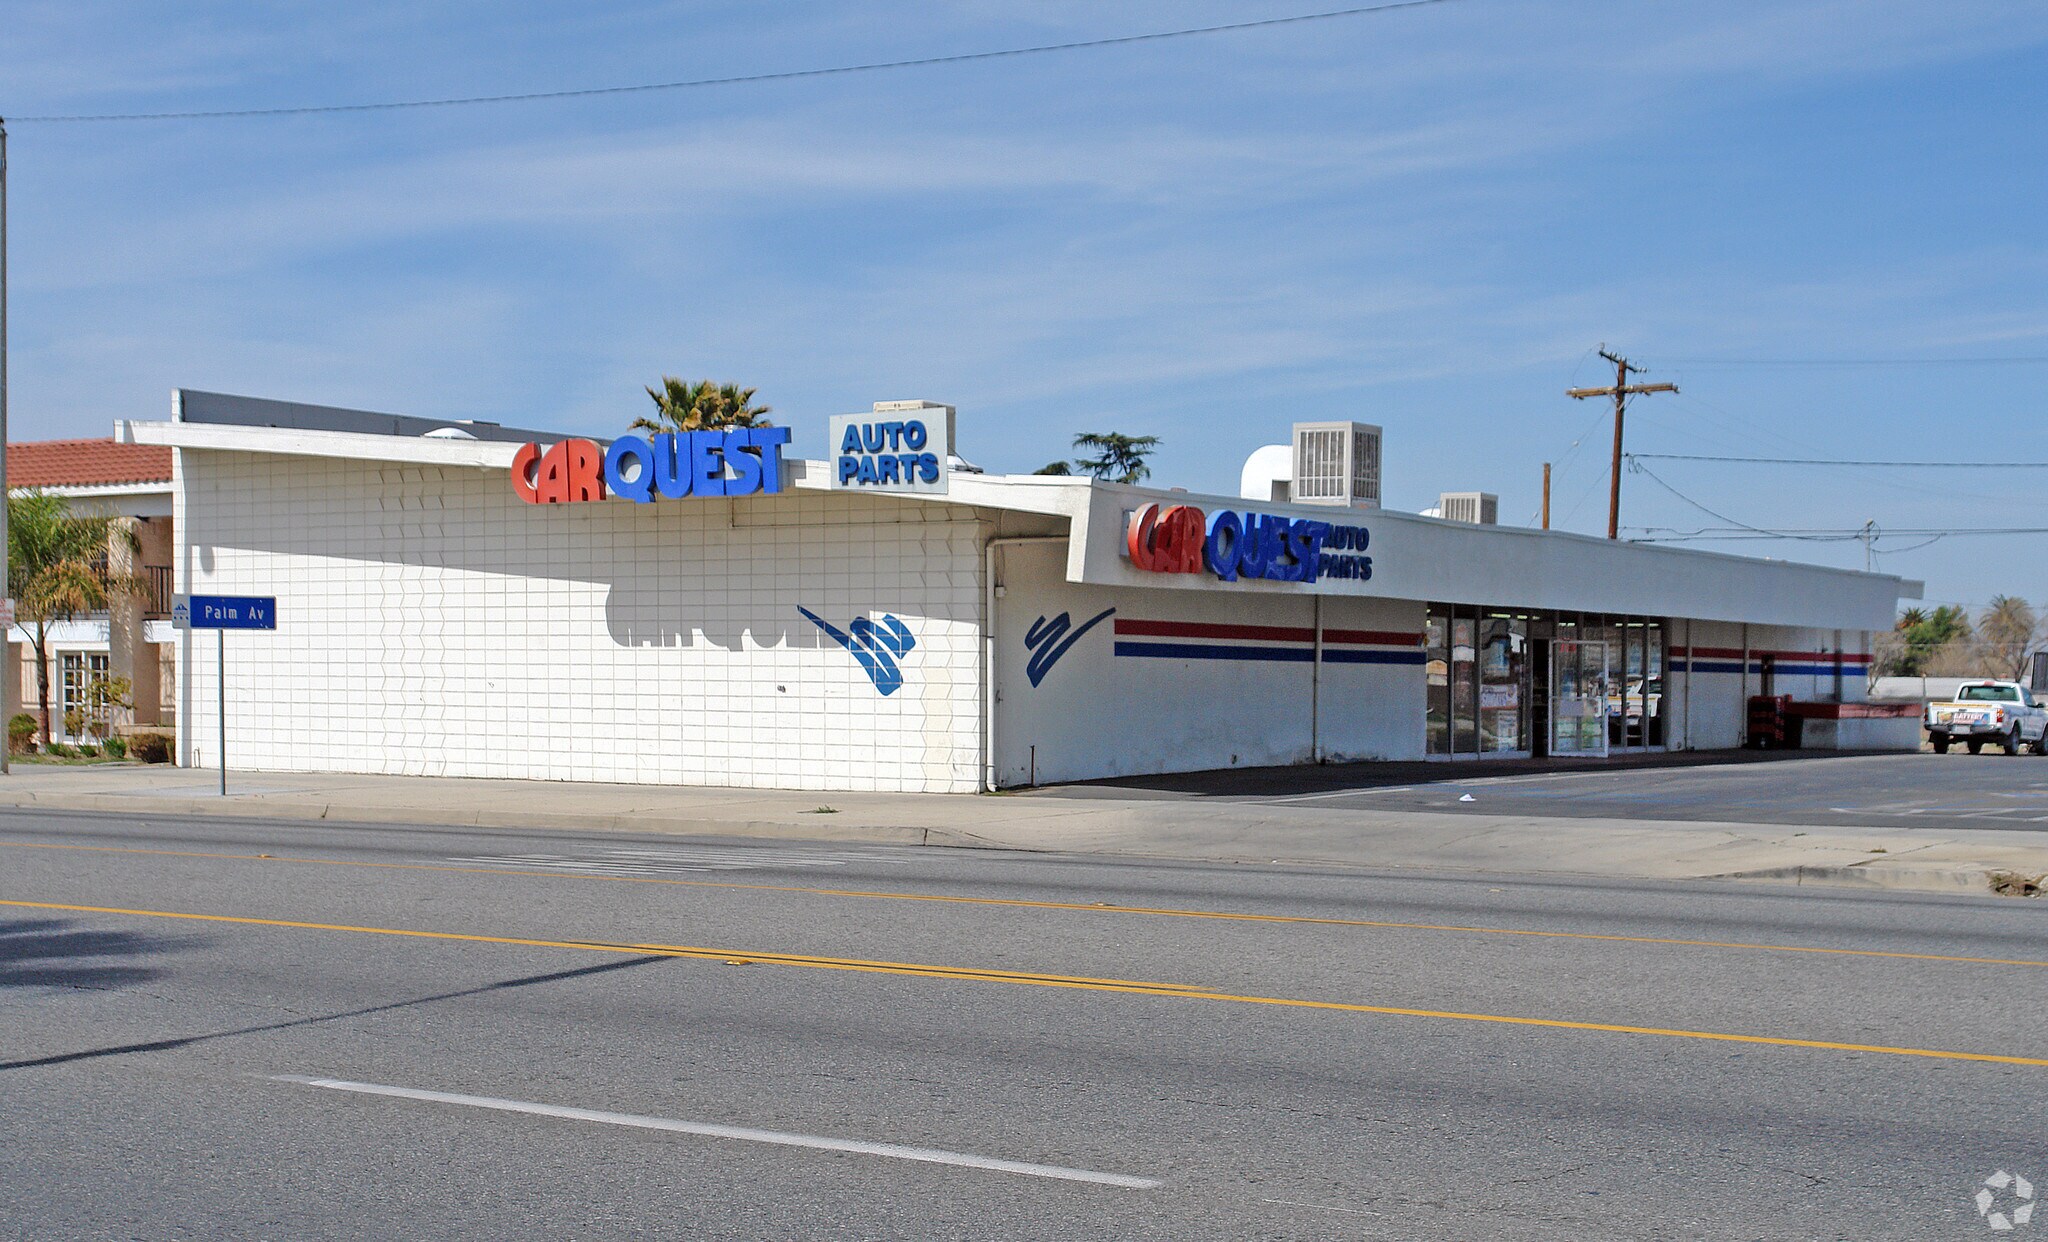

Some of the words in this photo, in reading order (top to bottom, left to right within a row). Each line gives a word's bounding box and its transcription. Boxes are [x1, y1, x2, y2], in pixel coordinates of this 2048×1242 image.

[841, 420, 927, 454] AUTO
[838, 453, 939, 484] PARTS
[1318, 554, 1372, 580] PARTS
[205, 605, 238, 620] Palm
[248, 606, 264, 620] Av
